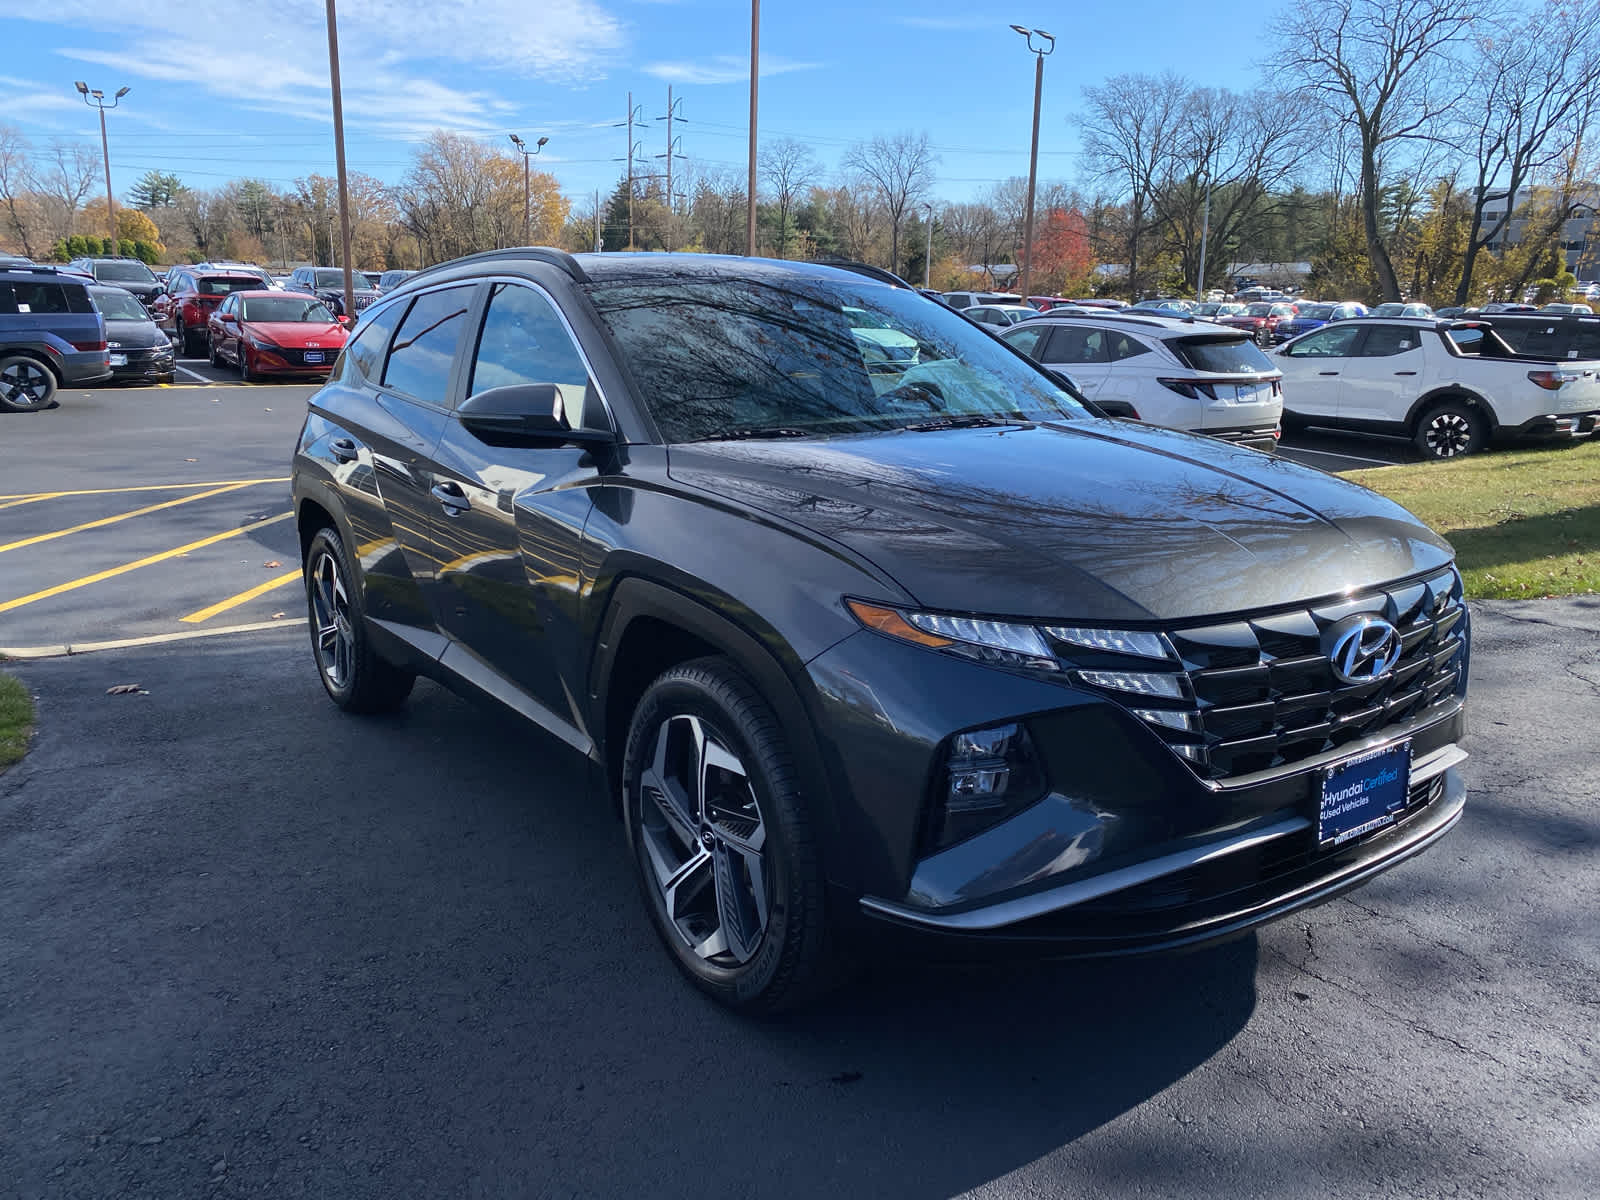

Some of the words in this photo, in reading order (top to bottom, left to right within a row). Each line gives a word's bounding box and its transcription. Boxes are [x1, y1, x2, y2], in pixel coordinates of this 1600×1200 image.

[1324, 779, 1364, 807] Hyundai
[1363, 767, 1398, 791] Certified
[1323, 805, 1341, 820] Used
[1341, 796, 1369, 813] Vehicles
